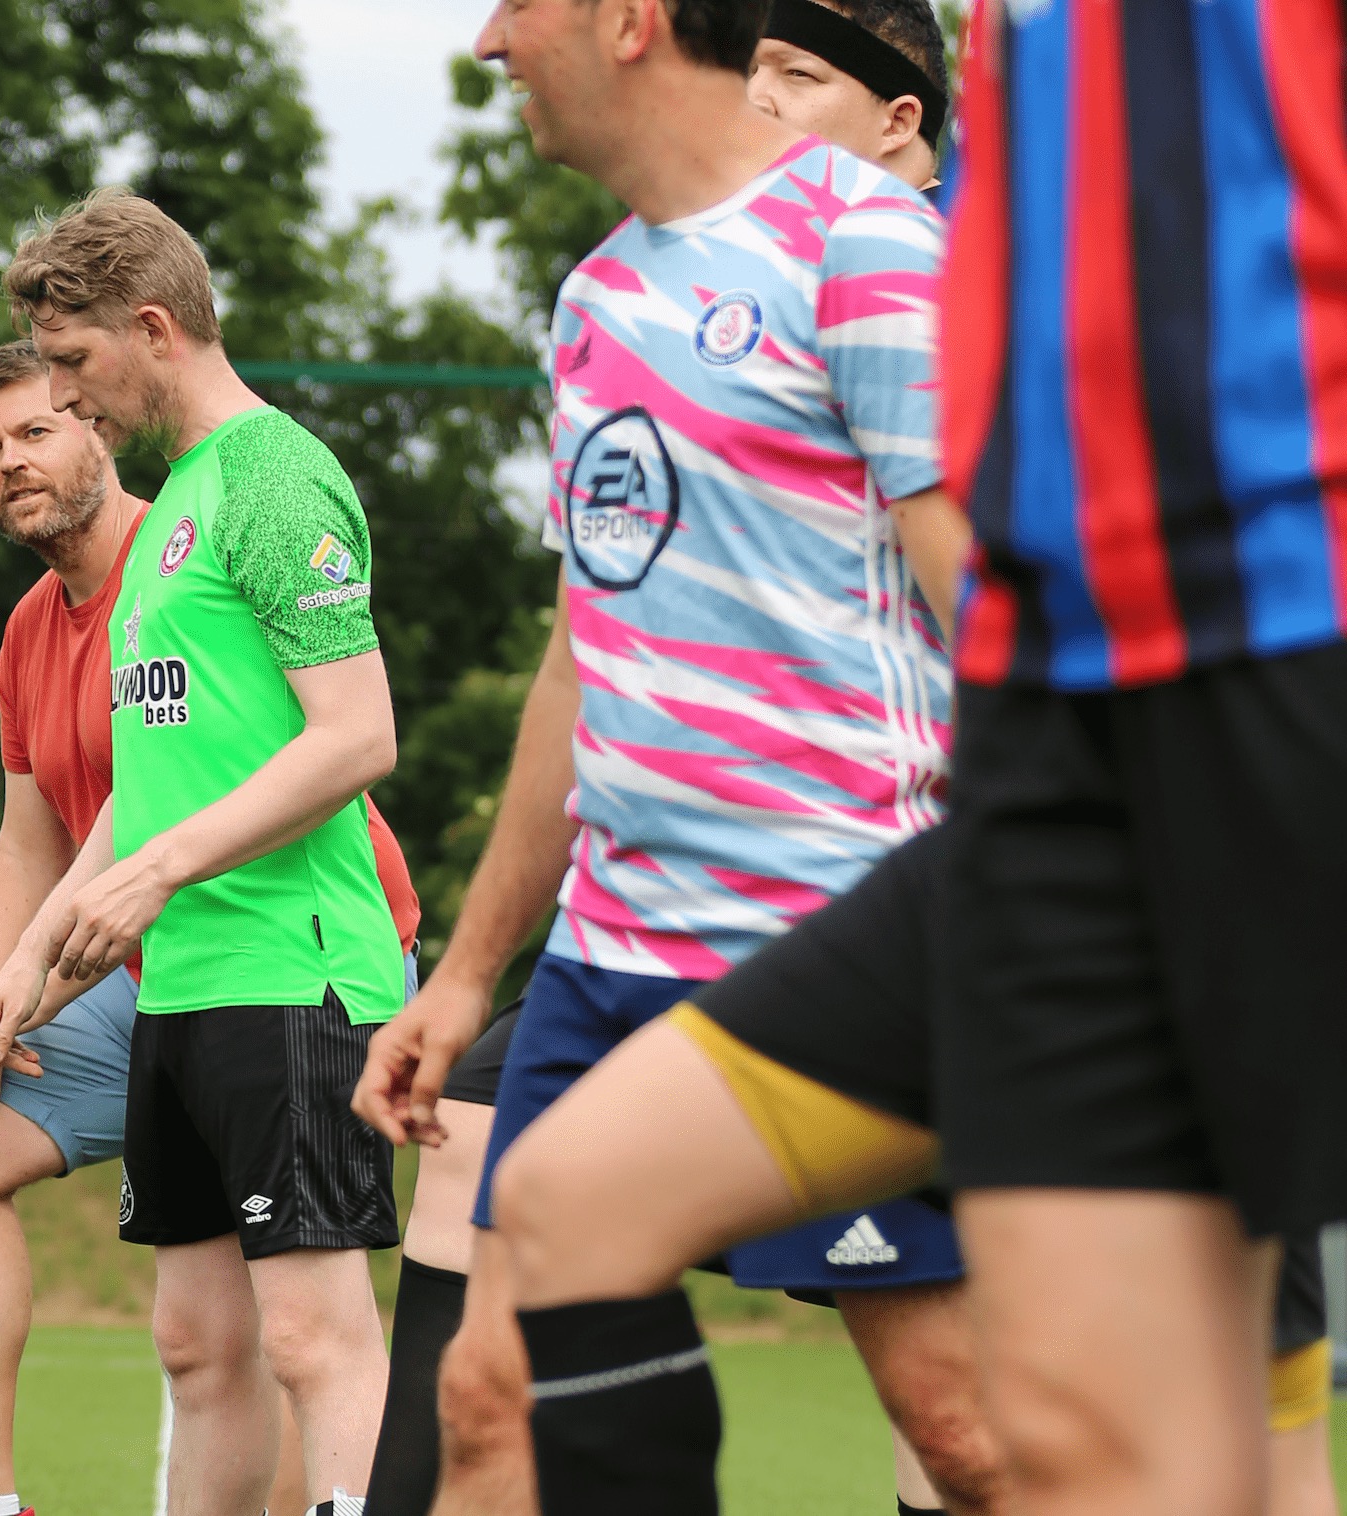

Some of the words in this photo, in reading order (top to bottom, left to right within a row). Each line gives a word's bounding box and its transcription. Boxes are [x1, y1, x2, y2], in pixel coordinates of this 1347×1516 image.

[298, 584, 371, 609] SafetyCultur
[145, 702, 187, 725] bets
[245, 1212, 272, 1224] umbro
[825, 1244, 900, 1266] adidas
